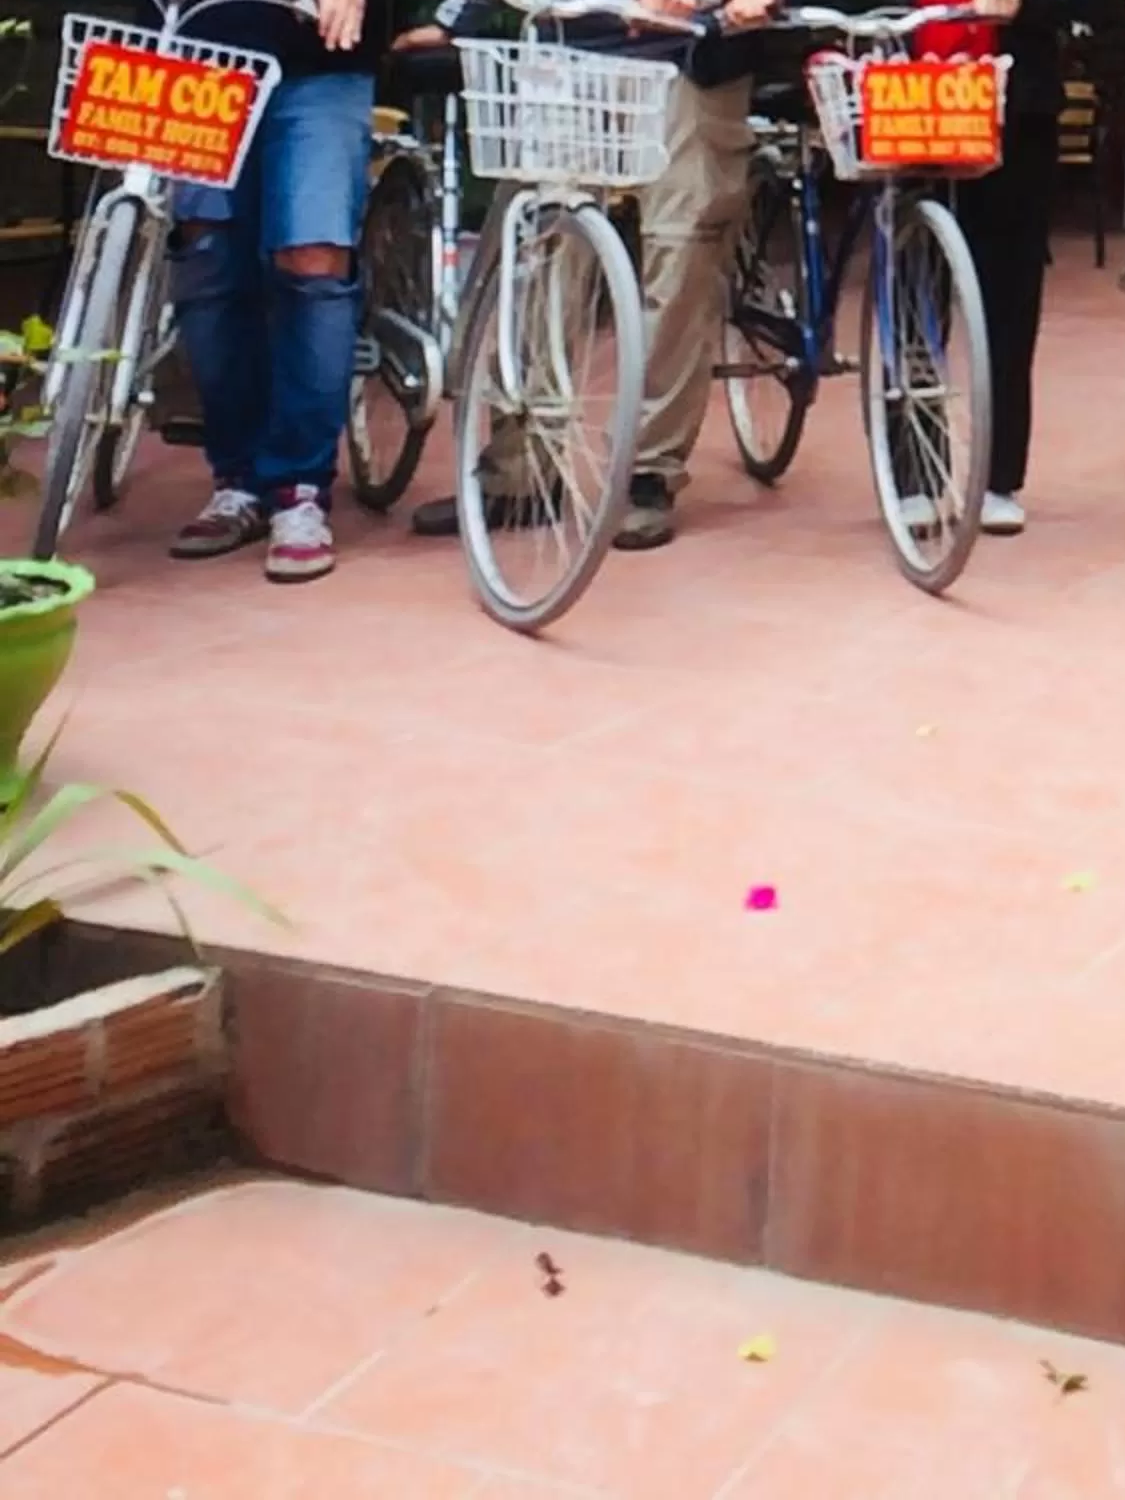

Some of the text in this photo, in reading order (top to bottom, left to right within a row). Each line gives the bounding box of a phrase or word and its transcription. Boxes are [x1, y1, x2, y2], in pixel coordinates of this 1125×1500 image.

[88, 56, 166, 107] TAM
[867, 72, 931, 110] TAM
[76, 102, 229, 150] FAMILY HOTEL
